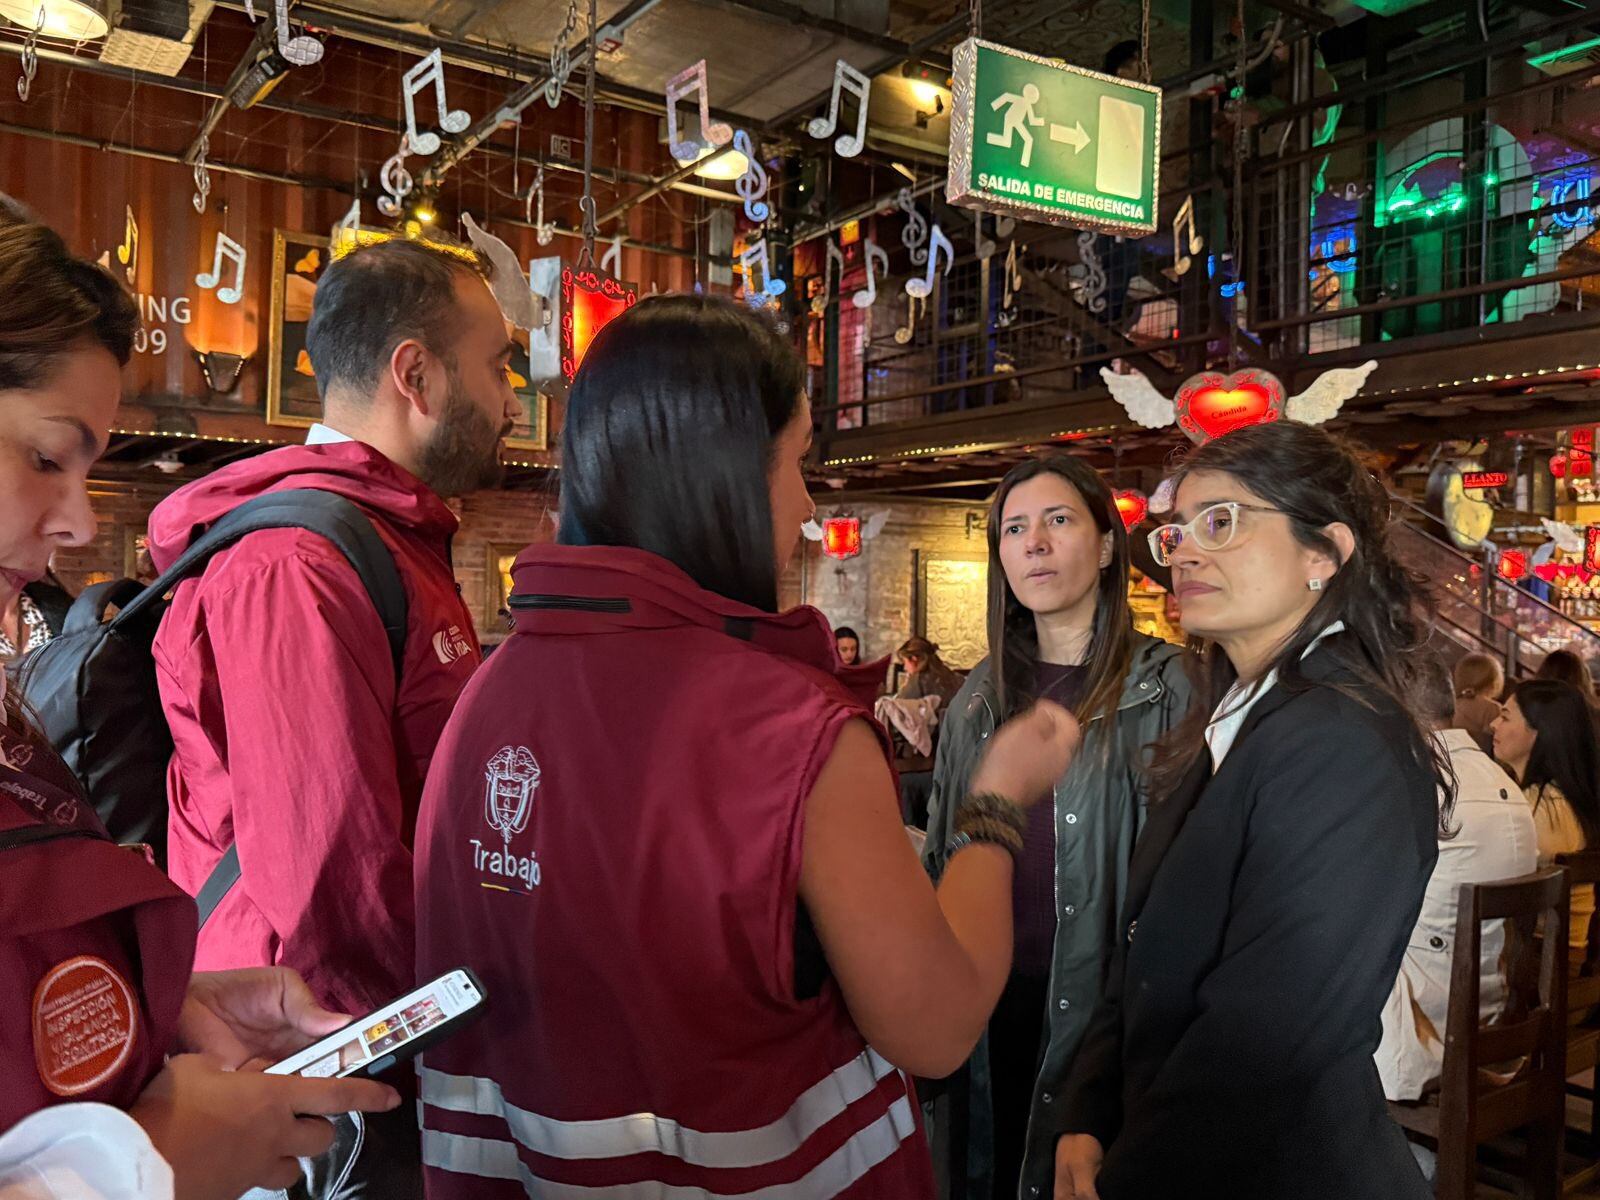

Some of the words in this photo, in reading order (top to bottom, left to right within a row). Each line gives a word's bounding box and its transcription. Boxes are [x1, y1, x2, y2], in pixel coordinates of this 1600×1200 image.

[978, 173, 1031, 196] SALIDA
[1034, 184, 1053, 200] DE
[1056, 189, 1144, 219] EMERGENCIA
[133, 293, 191, 324] ING
[470, 839, 541, 890] Trabajo
